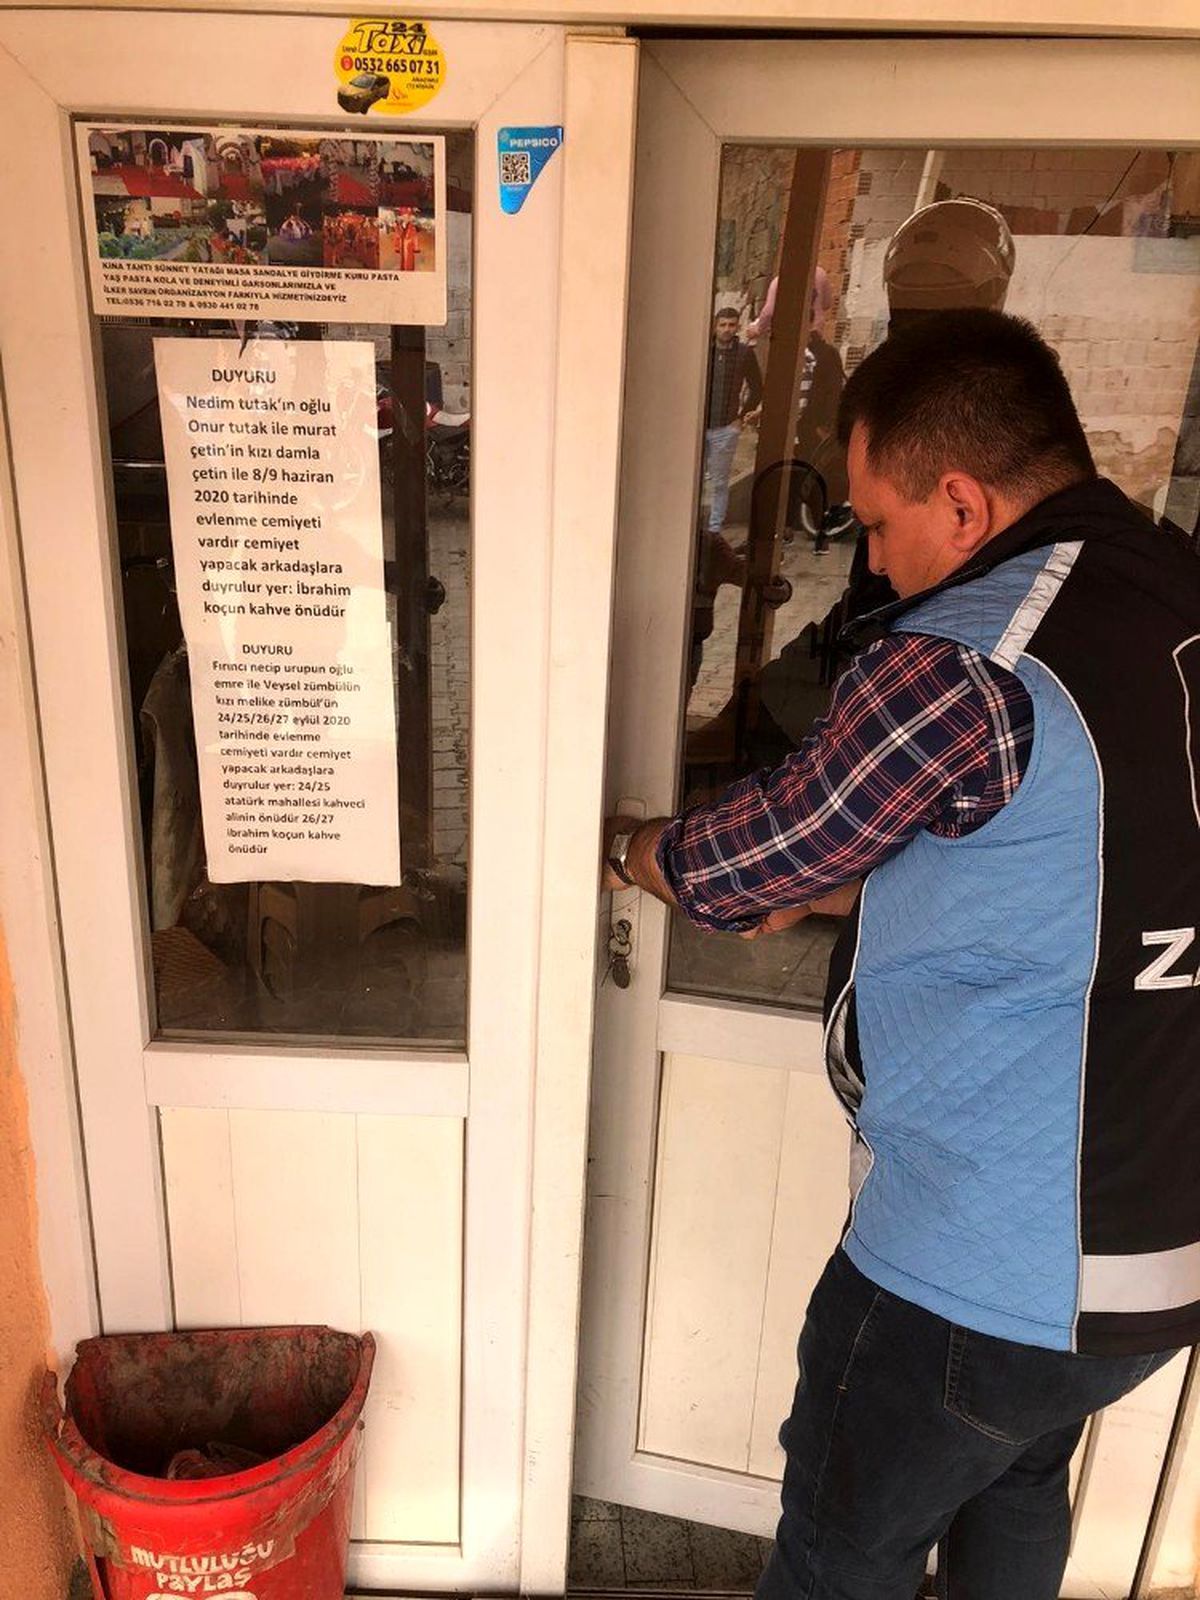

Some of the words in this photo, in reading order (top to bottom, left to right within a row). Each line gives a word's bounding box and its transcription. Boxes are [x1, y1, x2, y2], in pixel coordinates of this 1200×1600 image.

[353, 22, 426, 55] Taxi
[355, 57, 383, 72] 0532
[386, 59, 407, 73] 665
[410, 60, 423, 73] 07
[426, 60, 439, 74] 31
[510, 138, 558, 147] PEPSICO
[104, 274, 121, 282] YAŞ
[123, 275, 151, 283] PASTA
[154, 276, 176, 284] KOLA
[254, 269, 298, 277] SANDALYE
[236, 302, 246, 310] 02
[212, 369, 276, 384] DUYURU
[186, 396, 235, 410] Nedim
[299, 399, 331, 415] oğlu
[188, 420, 225, 433] Onur
[229, 422, 267, 435] tutak
[271, 422, 289, 435] ile
[293, 424, 336, 436] murat
[248, 445, 272, 458] kızı
[276, 446, 320, 460] damla
[192, 467, 227, 482] çetin
[232, 468, 248, 480] ile
[252, 469, 278, 483] 8/9
[282, 469, 334, 483] haziran
[194, 490, 229, 503] 2020
[233, 490, 298, 505] tarihinde
[196, 513, 257, 527] evlenme
[261, 515, 322, 531] cemiyeti
[198, 536, 239, 548] vardır
[244, 537, 299, 552] cemiyet
[200, 559, 257, 572] yapacak
[261, 560, 343, 575] arkadaşlara
[202, 580, 261, 595] duyrulur
[266, 584, 292, 596] yer:
[204, 601, 246, 616] koçun
[249, 602, 291, 615] kahve
[295, 604, 346, 617] önüdür
[242, 644, 293, 655] DUYURU
[250, 662, 281, 674] necip
[284, 665, 326, 675] urupun
[329, 664, 354, 677] oğlu
[214, 679, 244, 689] emre
[247, 679, 261, 689] ile
[263, 680, 300, 692] Veysel
[303, 681, 361, 692] zümbülün
[215, 696, 234, 706] kızı
[237, 697, 275, 707] melike
[218, 713, 289, 724] 24/25/26/27
[293, 715, 320, 727] eylül
[323, 715, 350, 725] 2020
[219, 731, 269, 741] tarihinde
[273, 732, 321, 742] evlenme
[220, 747, 268, 759] cemiyeti
[271, 748, 303, 758] vardır
[307, 750, 351, 760] cemiyet
[221, 764, 267, 774] yapacak
[270, 765, 335, 777] arkadaşlara
[223, 780, 270, 791] duyrulur
[273, 784, 295, 792] yer:
[298, 782, 331, 793] 24/25
[225, 797, 265, 807] atatürk
[268, 798, 320, 808] mahallesi
[323, 799, 366, 809] kahveci
[226, 813, 256, 822] alinin
[258, 814, 299, 823] önüdür
[302, 814, 334, 825] 26/27
[272, 829, 305, 841] koçun
[308, 831, 341, 841] kahve
[229, 844, 268, 854] önüdür
[1134, 927, 1200, 990] Z
